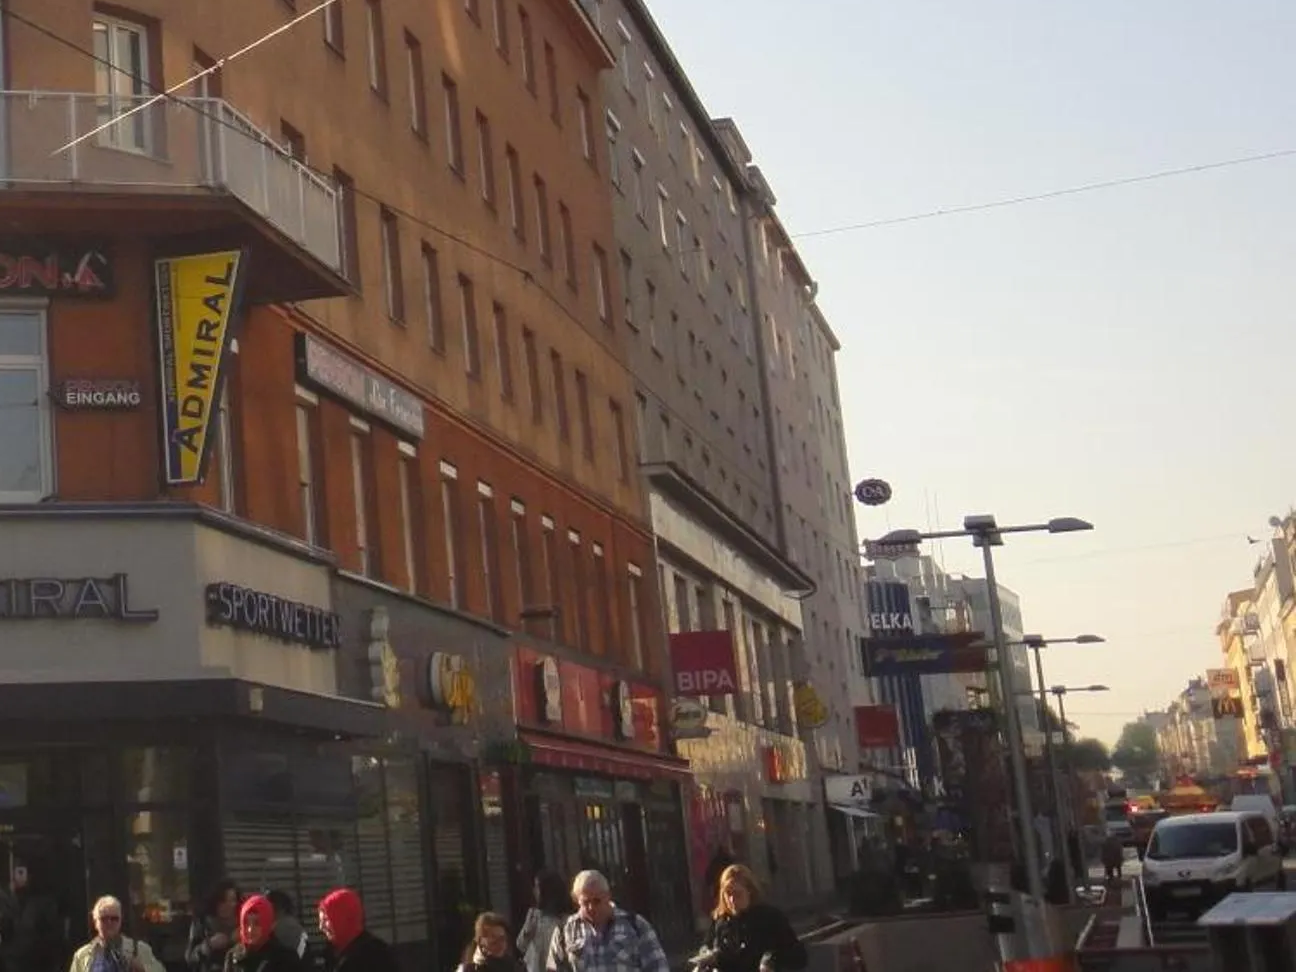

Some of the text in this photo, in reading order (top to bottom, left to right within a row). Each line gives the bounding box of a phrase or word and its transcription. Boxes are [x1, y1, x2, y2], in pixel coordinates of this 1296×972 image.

[177, 260, 234, 455] ADMIRAL
[66, 391, 141, 405] EINGANG
[216, 583, 343, 647] SPORTWETTEN
[865, 612, 912, 629] ELKA
[677, 669, 735, 692] BIPA
